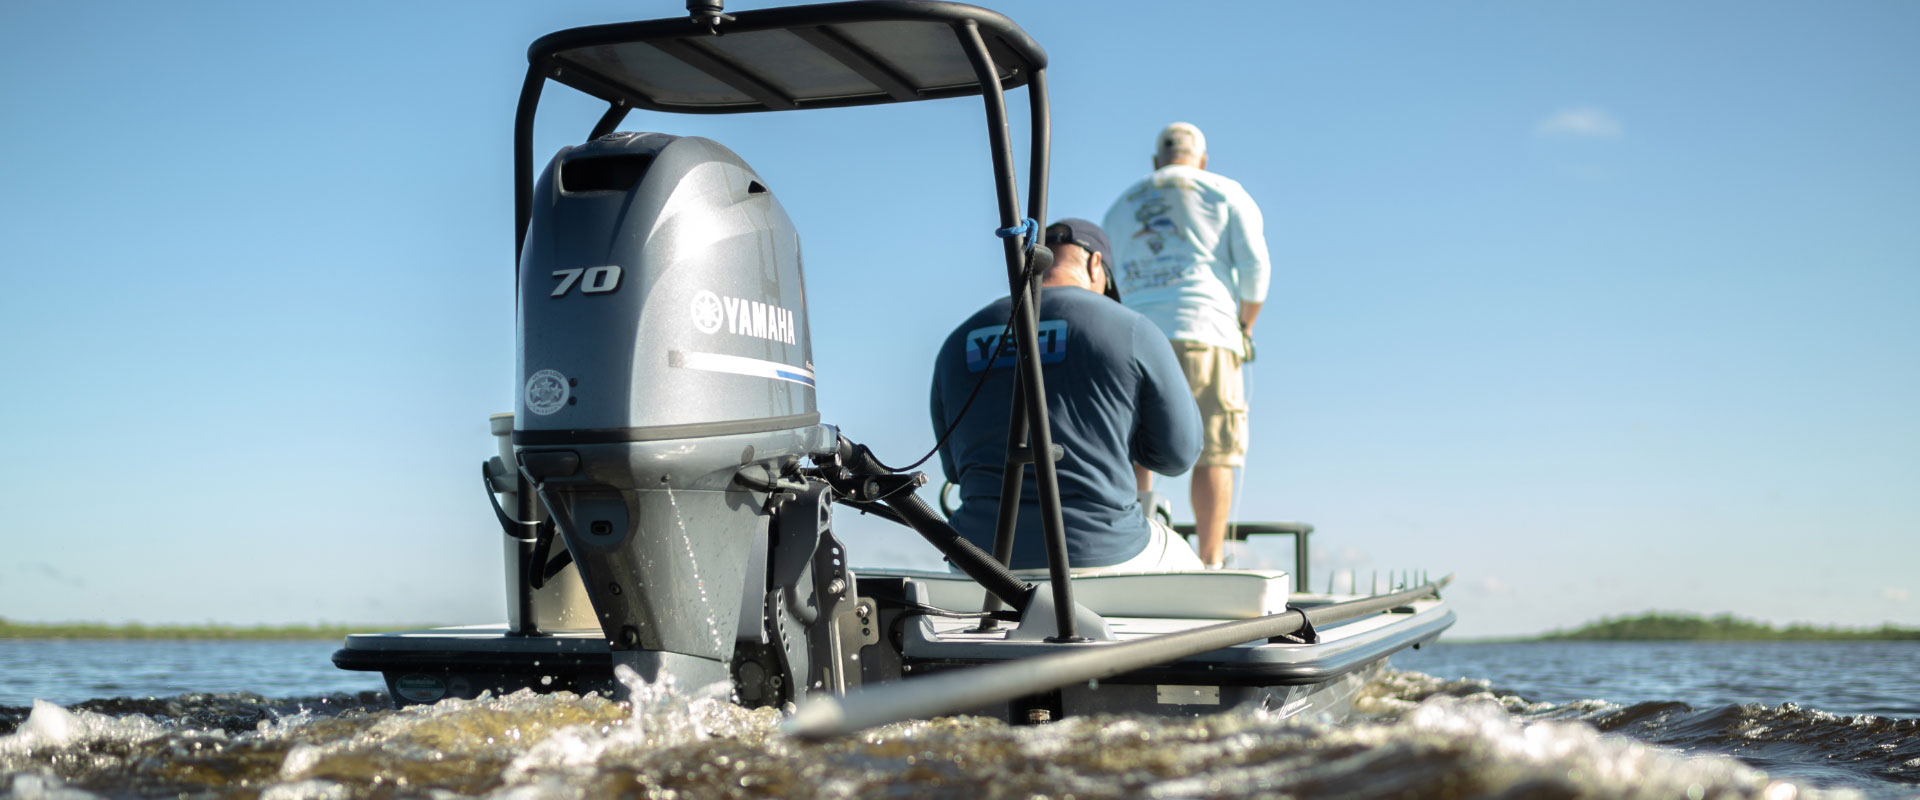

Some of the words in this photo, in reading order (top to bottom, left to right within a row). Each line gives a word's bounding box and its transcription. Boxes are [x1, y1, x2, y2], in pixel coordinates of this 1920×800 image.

[550, 265, 621, 296] 70
[723, 296, 796, 345] YAMAHA
[974, 329, 1057, 360] YEI
